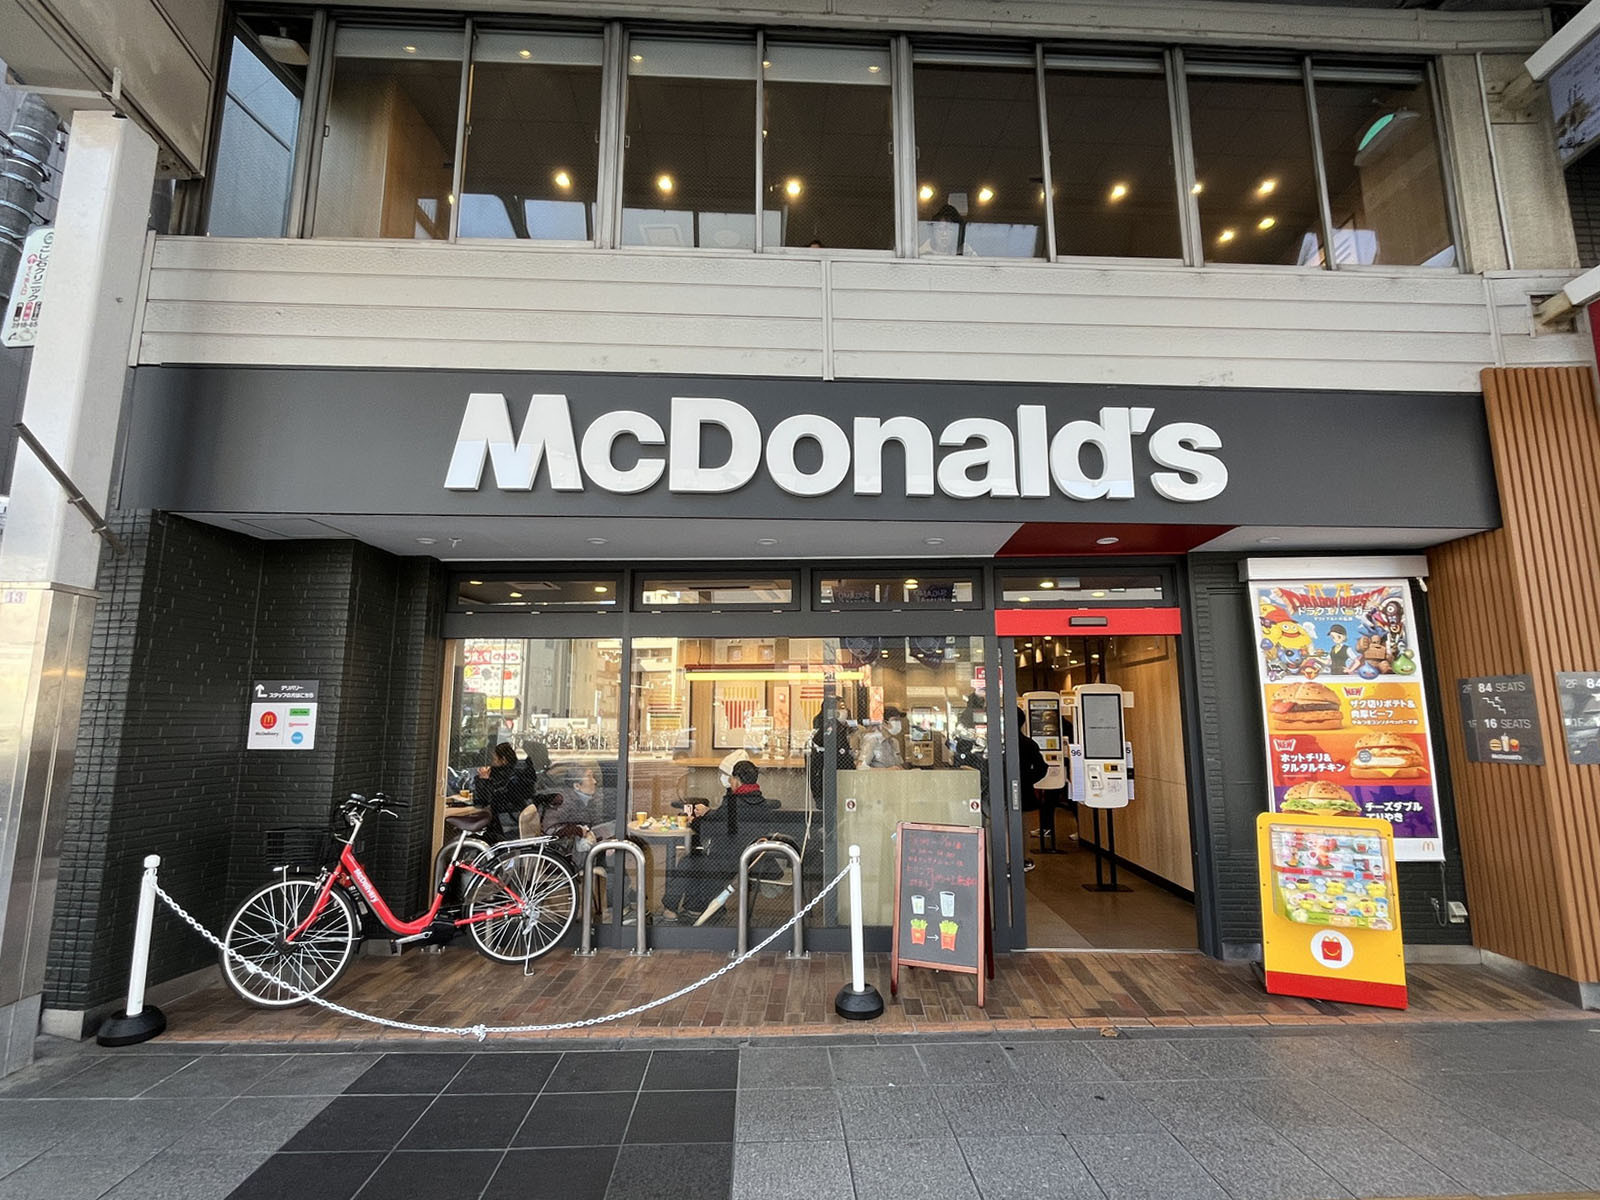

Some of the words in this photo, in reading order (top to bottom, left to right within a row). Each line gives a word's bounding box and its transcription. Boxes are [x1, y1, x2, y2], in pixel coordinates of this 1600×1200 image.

[444, 392, 1229, 503] McDonald's
[8, 591, 24, 603] 13
[1344, 687, 1364, 696] NEW
[1478, 683, 1493, 693] 84
[1495, 681, 1526, 692] SEATS
[1484, 719, 1498, 729] 16
[1500, 719, 1532, 729] SEATS
[1281, 763, 1347, 773] タルタルチキン
[1365, 801, 1423, 812] チーズダブル
